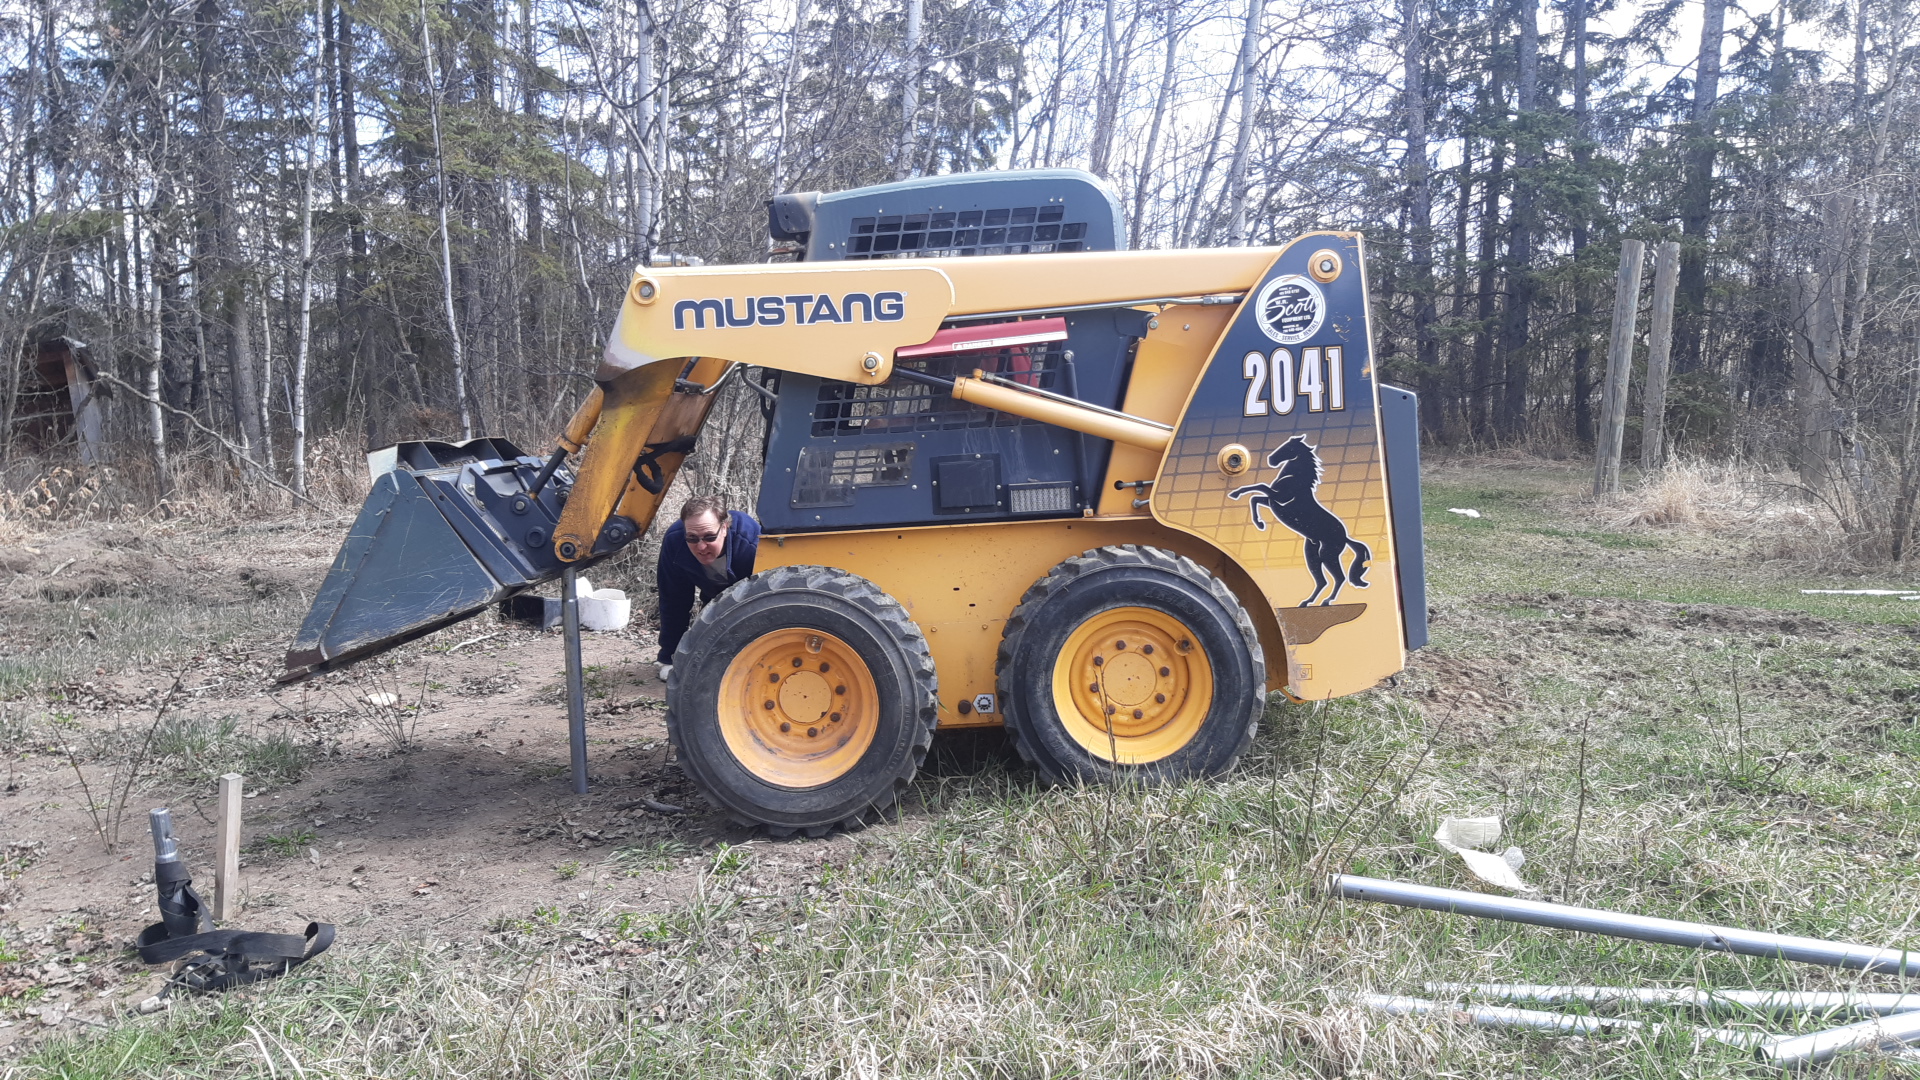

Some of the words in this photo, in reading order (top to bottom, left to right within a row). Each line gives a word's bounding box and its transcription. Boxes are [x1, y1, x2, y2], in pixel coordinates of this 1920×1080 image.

[674, 292, 905, 330] MUSTANG
[1260, 293, 1320, 324] Scott
[1266, 326, 1280, 338] SALES
[1303, 320, 1319, 337] RENTALS
[1243, 345, 1345, 417] 2041
